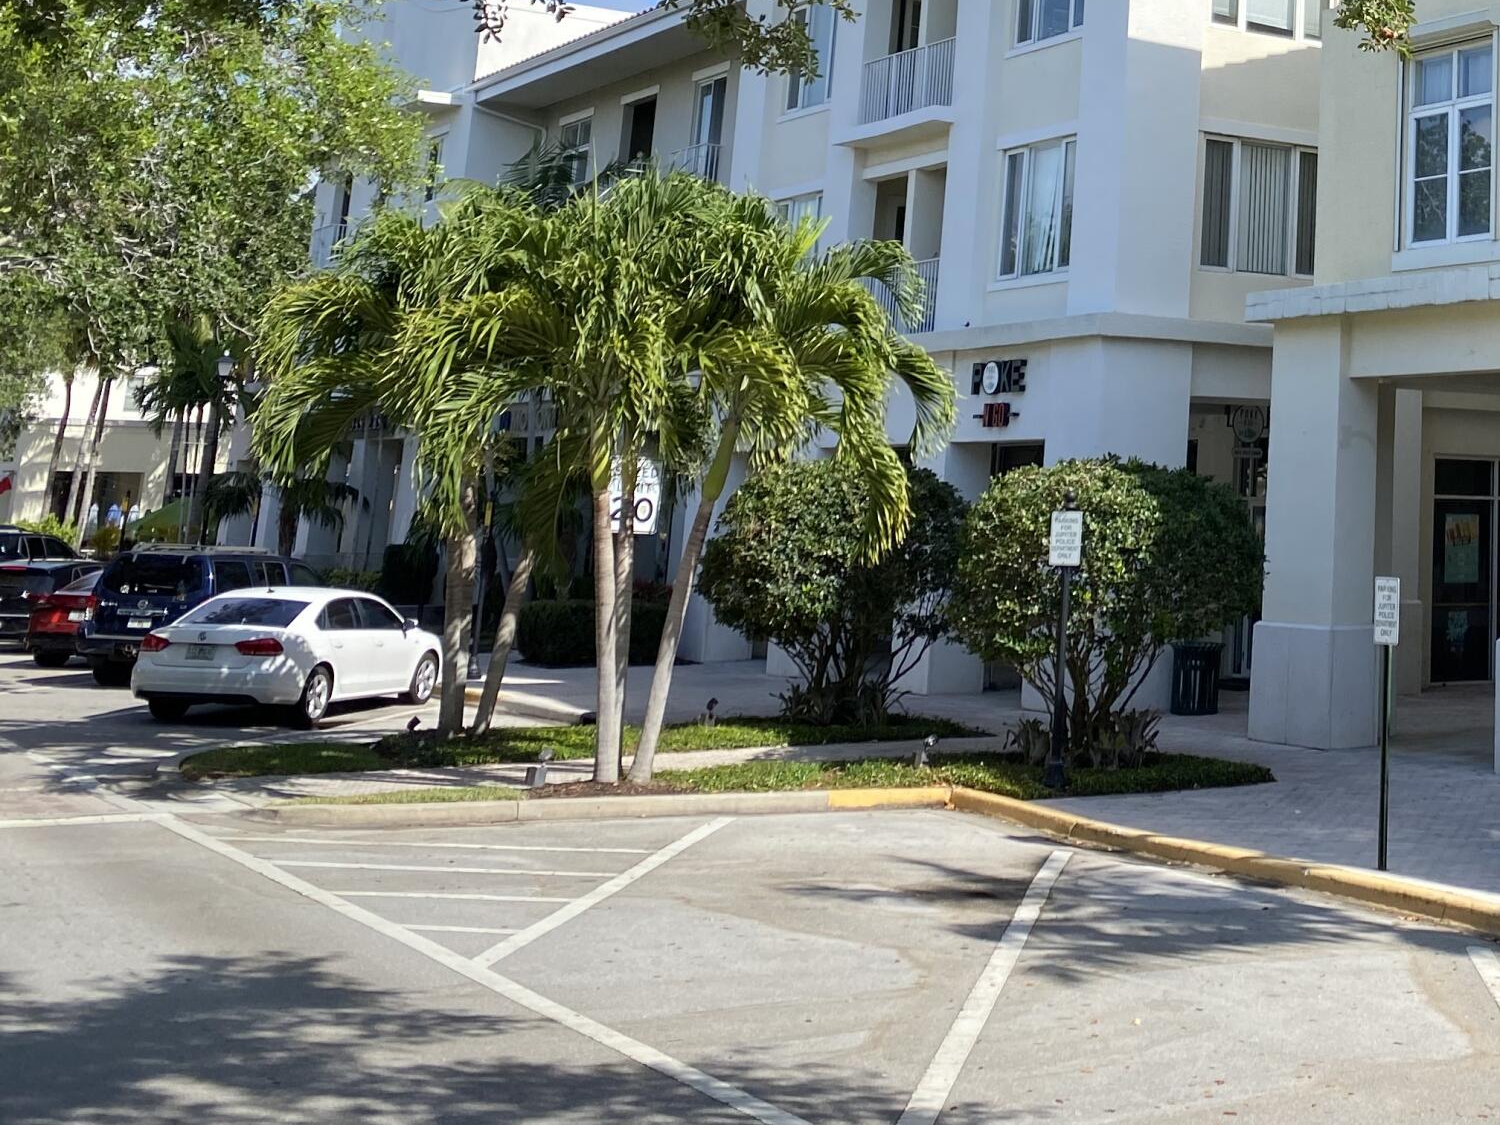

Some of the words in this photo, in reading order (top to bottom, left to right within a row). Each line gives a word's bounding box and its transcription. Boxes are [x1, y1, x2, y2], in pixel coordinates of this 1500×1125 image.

[971, 360, 1028, 396] POKE
[1377, 585, 1397, 593] PARKING
[1378, 603, 1396, 611] JUPITER
[1378, 611, 1395, 619] POLICE
[1375, 620, 1397, 628] DEPARTMENT
[1380, 628, 1392, 636] ONLY
